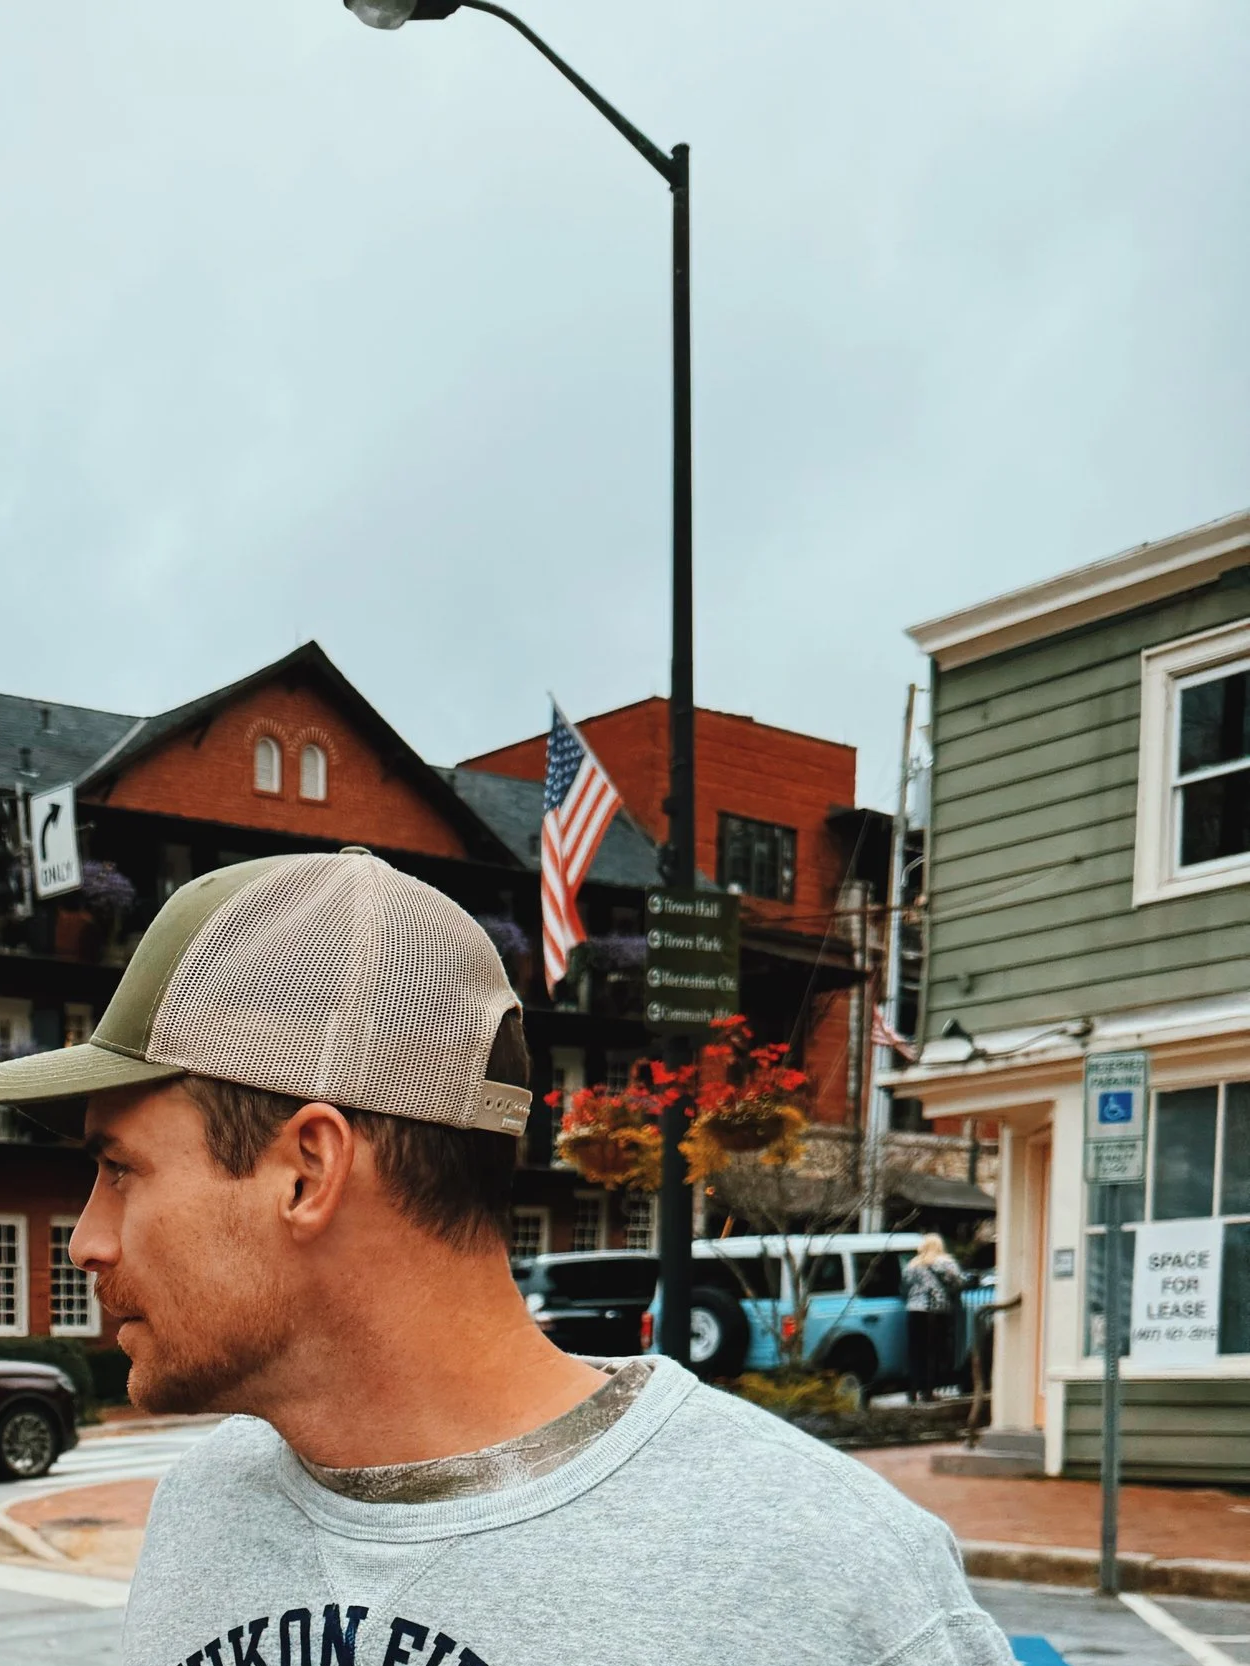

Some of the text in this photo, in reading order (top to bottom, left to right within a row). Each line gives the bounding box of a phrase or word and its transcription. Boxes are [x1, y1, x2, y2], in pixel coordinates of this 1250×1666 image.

[40, 861, 74, 887] ONLY
[664, 898, 720, 919] Town Hall
[664, 933, 722, 953] Town Park
[1147, 1251, 1211, 1272] SPACE
[1161, 1276, 1200, 1296] FOR
[1146, 1301, 1207, 1320] LEASE
